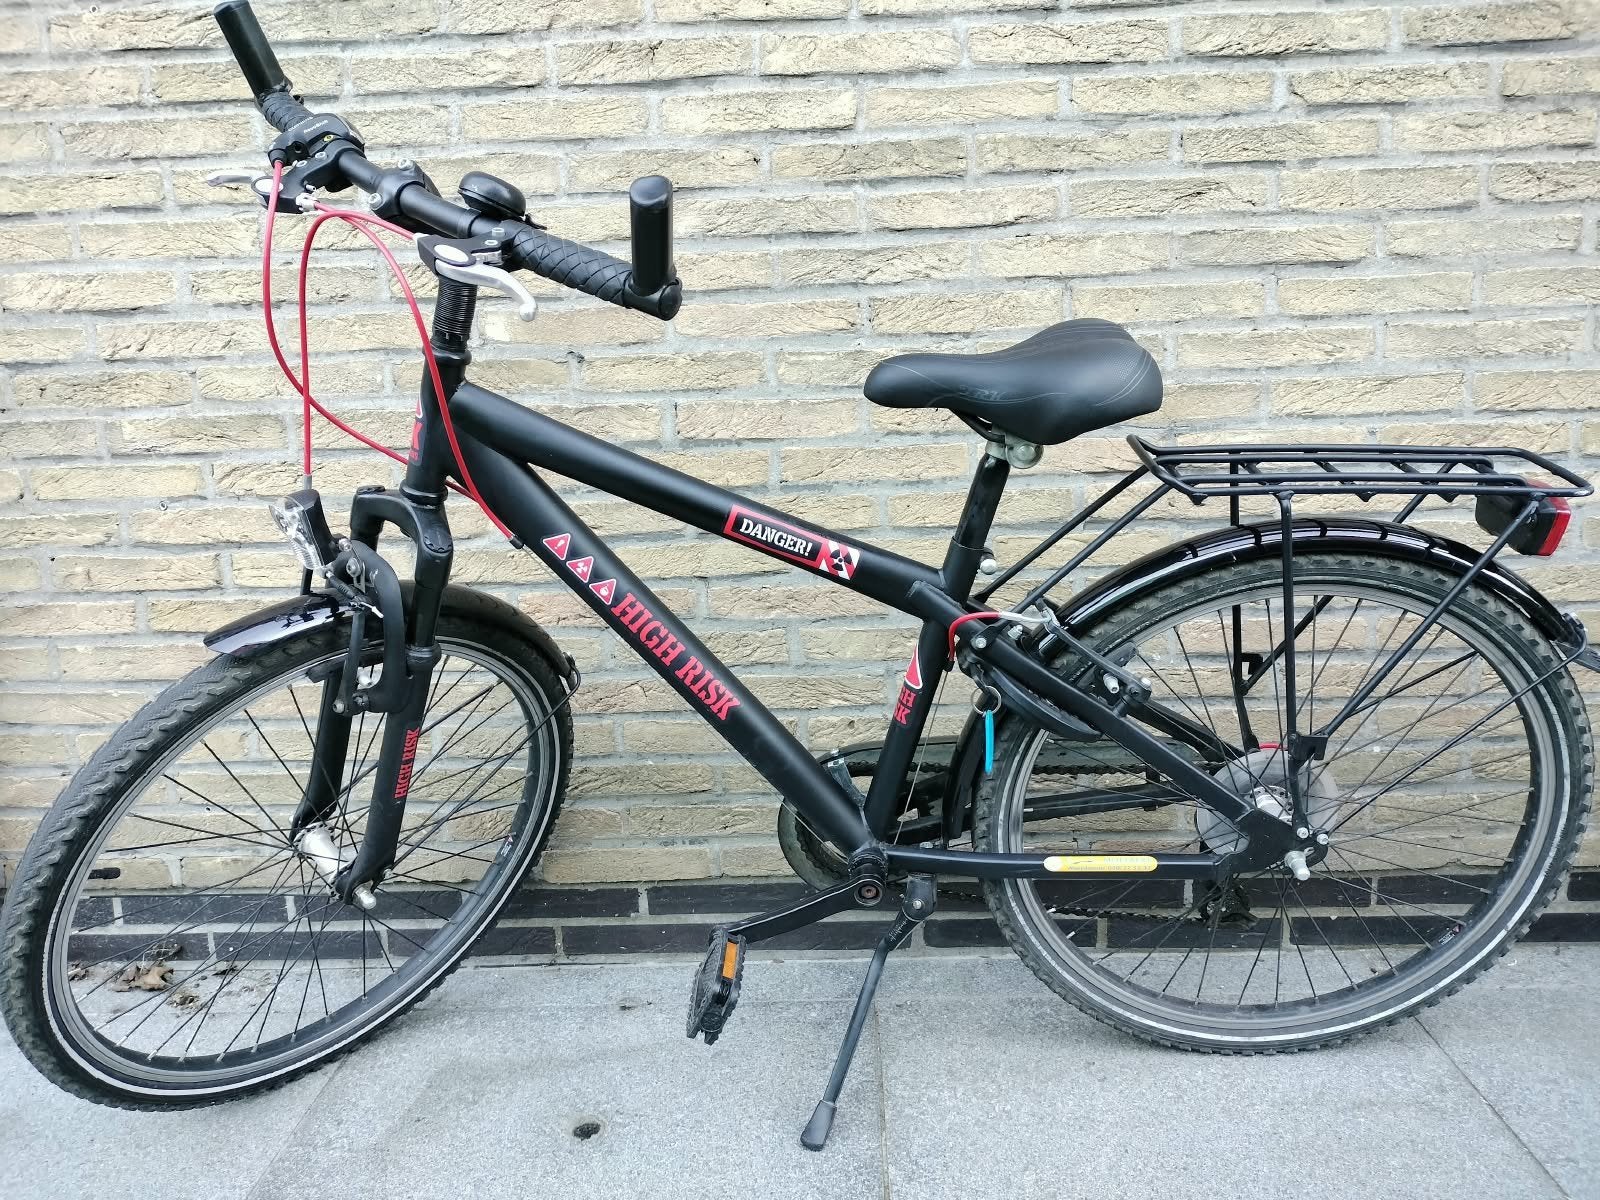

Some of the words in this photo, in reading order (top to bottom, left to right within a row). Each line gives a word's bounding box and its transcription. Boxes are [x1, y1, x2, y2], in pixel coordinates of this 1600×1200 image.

[740, 517, 813, 556] DANGER!
[611, 592, 686, 666] HIGH
[675, 656, 741, 720] RISK
[402, 726, 420, 761] RISK
[394, 762, 413, 798] HIGH
